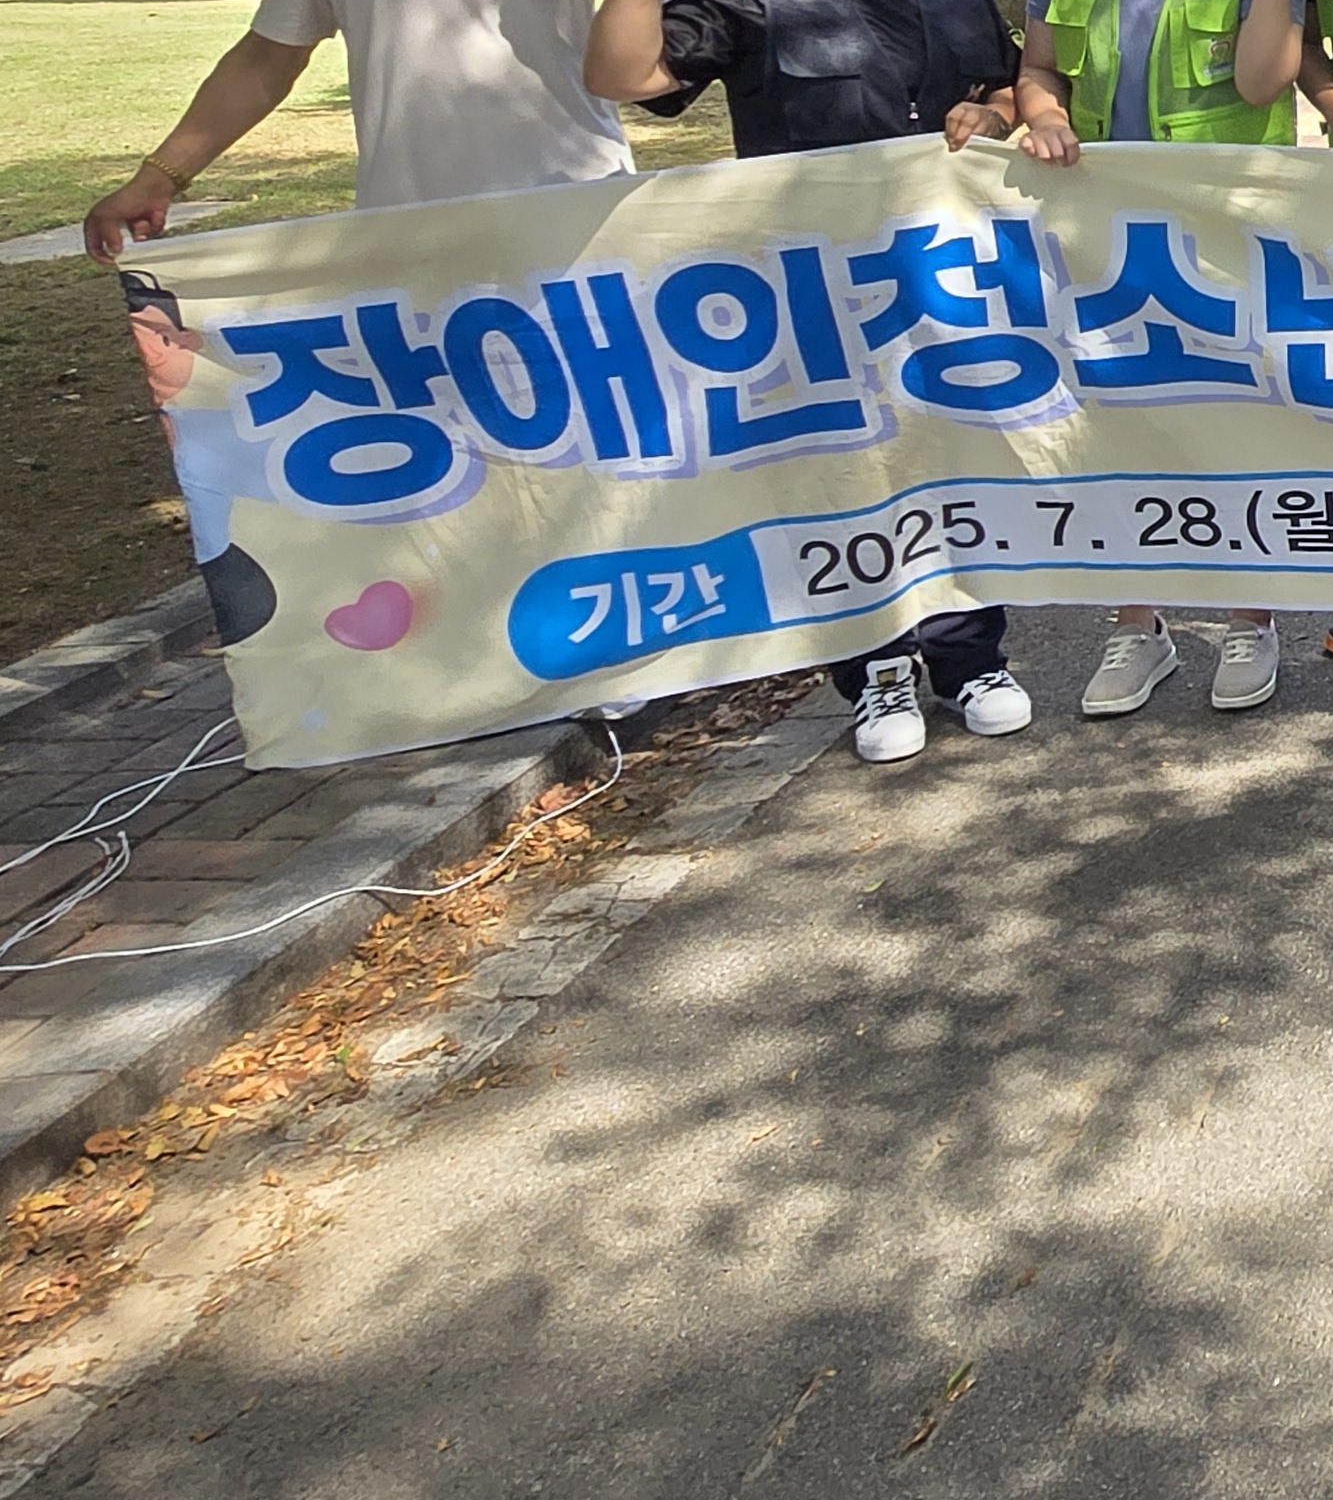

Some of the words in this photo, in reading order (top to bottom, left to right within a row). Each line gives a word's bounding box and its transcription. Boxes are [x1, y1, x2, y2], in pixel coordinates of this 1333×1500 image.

[799, 501, 1010, 597] 2025.
[1035, 502, 1105, 550] 7.
[567, 563, 726, 646] 기간
